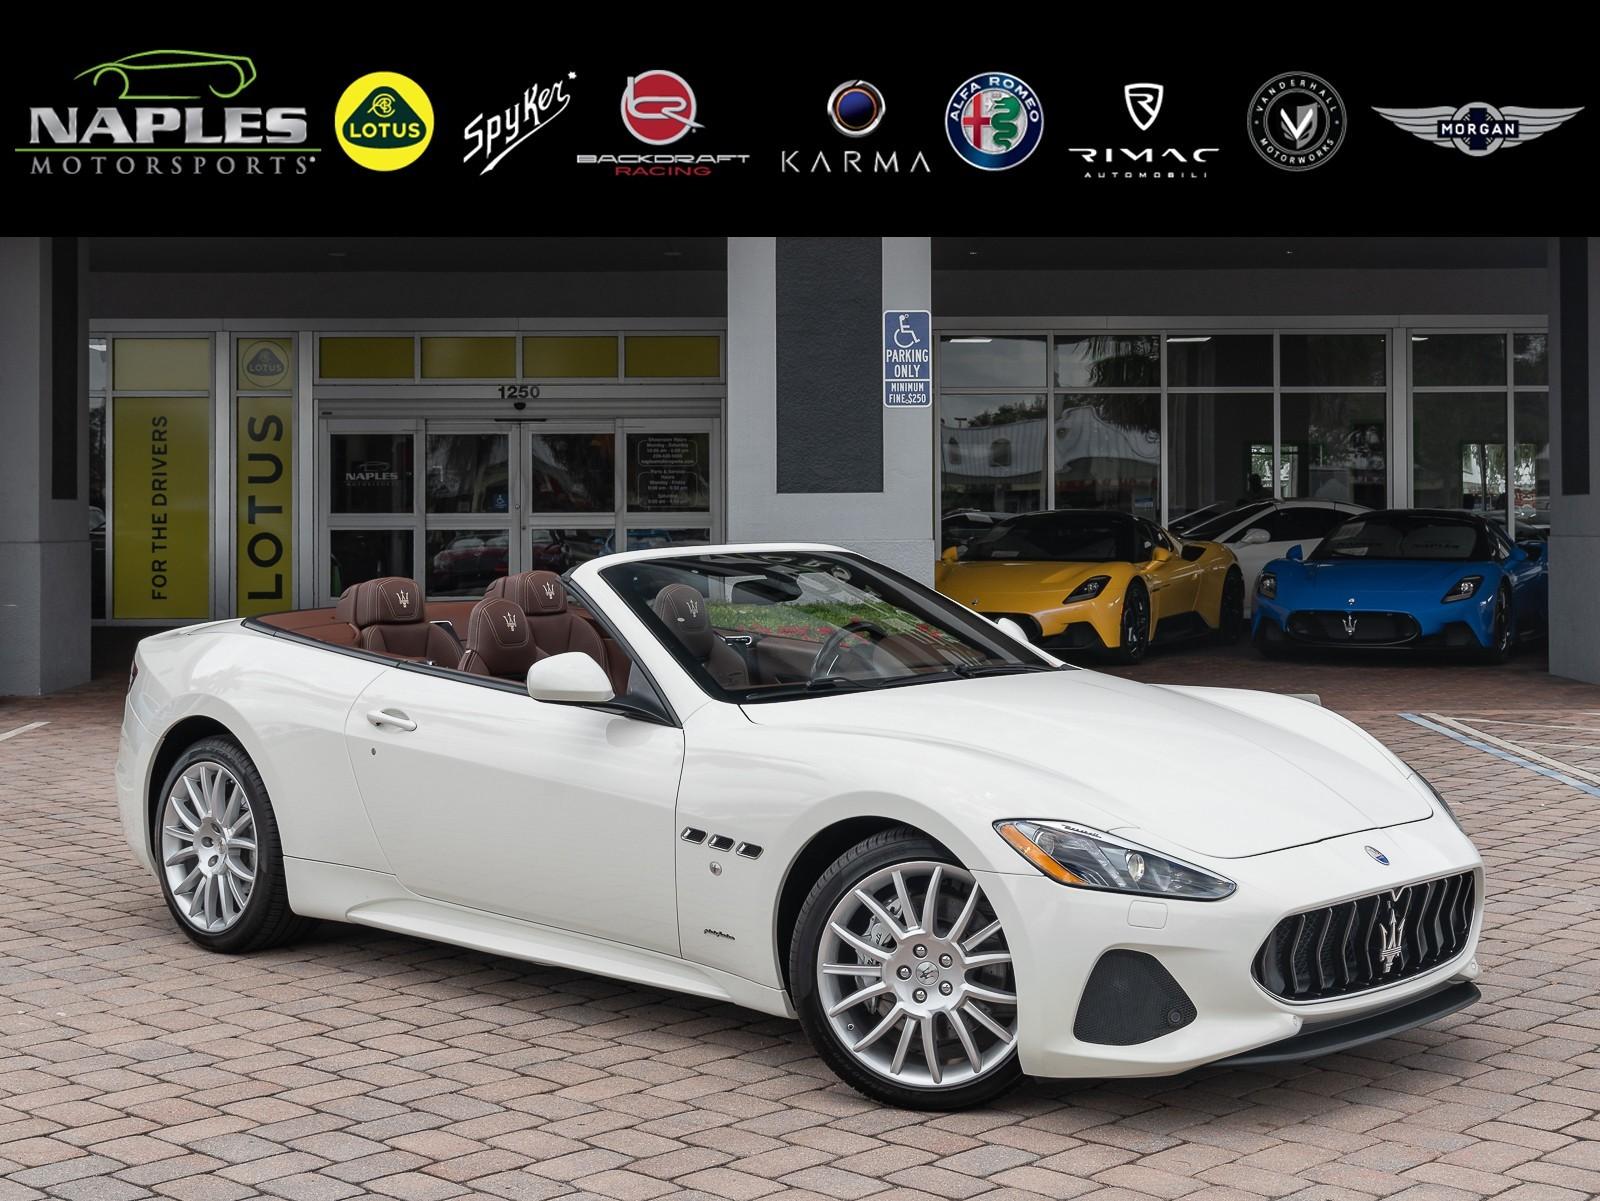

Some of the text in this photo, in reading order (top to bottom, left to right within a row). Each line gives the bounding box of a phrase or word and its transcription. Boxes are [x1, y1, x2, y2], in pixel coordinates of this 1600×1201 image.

[886, 349, 929, 363] PARKING
[250, 363, 283, 373] LOTUS
[894, 364, 920, 378] ONLY
[497, 384, 541, 400] 1250
[891, 382, 924, 392] MINIMUM
[888, 392, 927, 404] FINE $250
[345, 472, 399, 480] NAPLES
[151, 415, 168, 600] FOR THE DRIVERS
[247, 414, 284, 600] LOTUS
